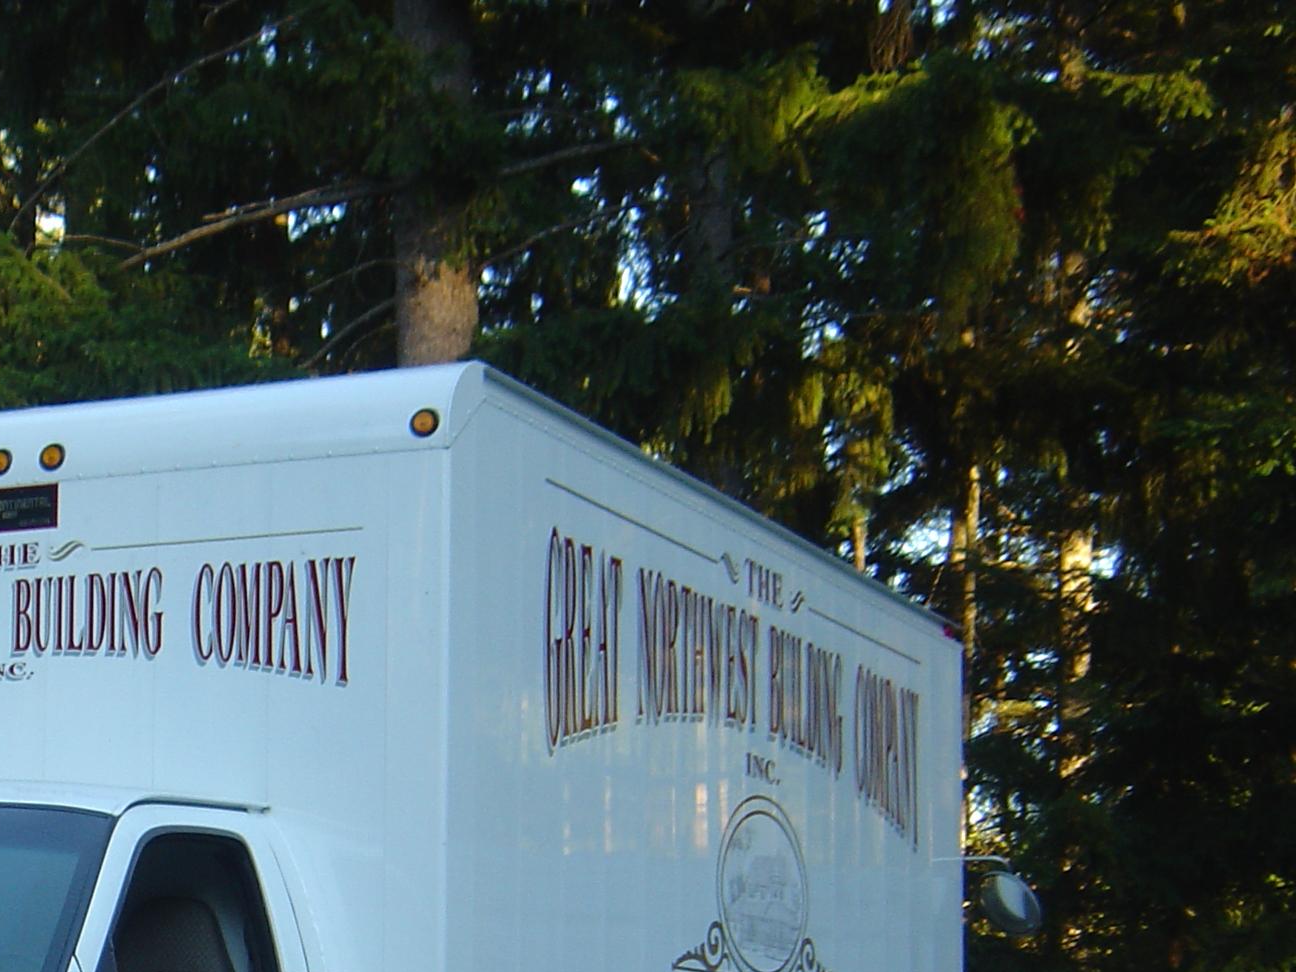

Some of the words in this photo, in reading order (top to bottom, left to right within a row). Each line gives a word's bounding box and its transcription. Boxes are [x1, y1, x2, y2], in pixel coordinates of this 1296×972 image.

[10, 566, 164, 660] BUILDING
[191, 556, 356, 687] COMPANY
[745, 558, 784, 609] THE
[544, 526, 623, 757] GREAT
[635, 567, 760, 733] NORTHWEST
[767, 624, 843, 781] BUILDING
[853, 663, 920, 853] COMPANY
[745, 752, 782, 786] INC.
